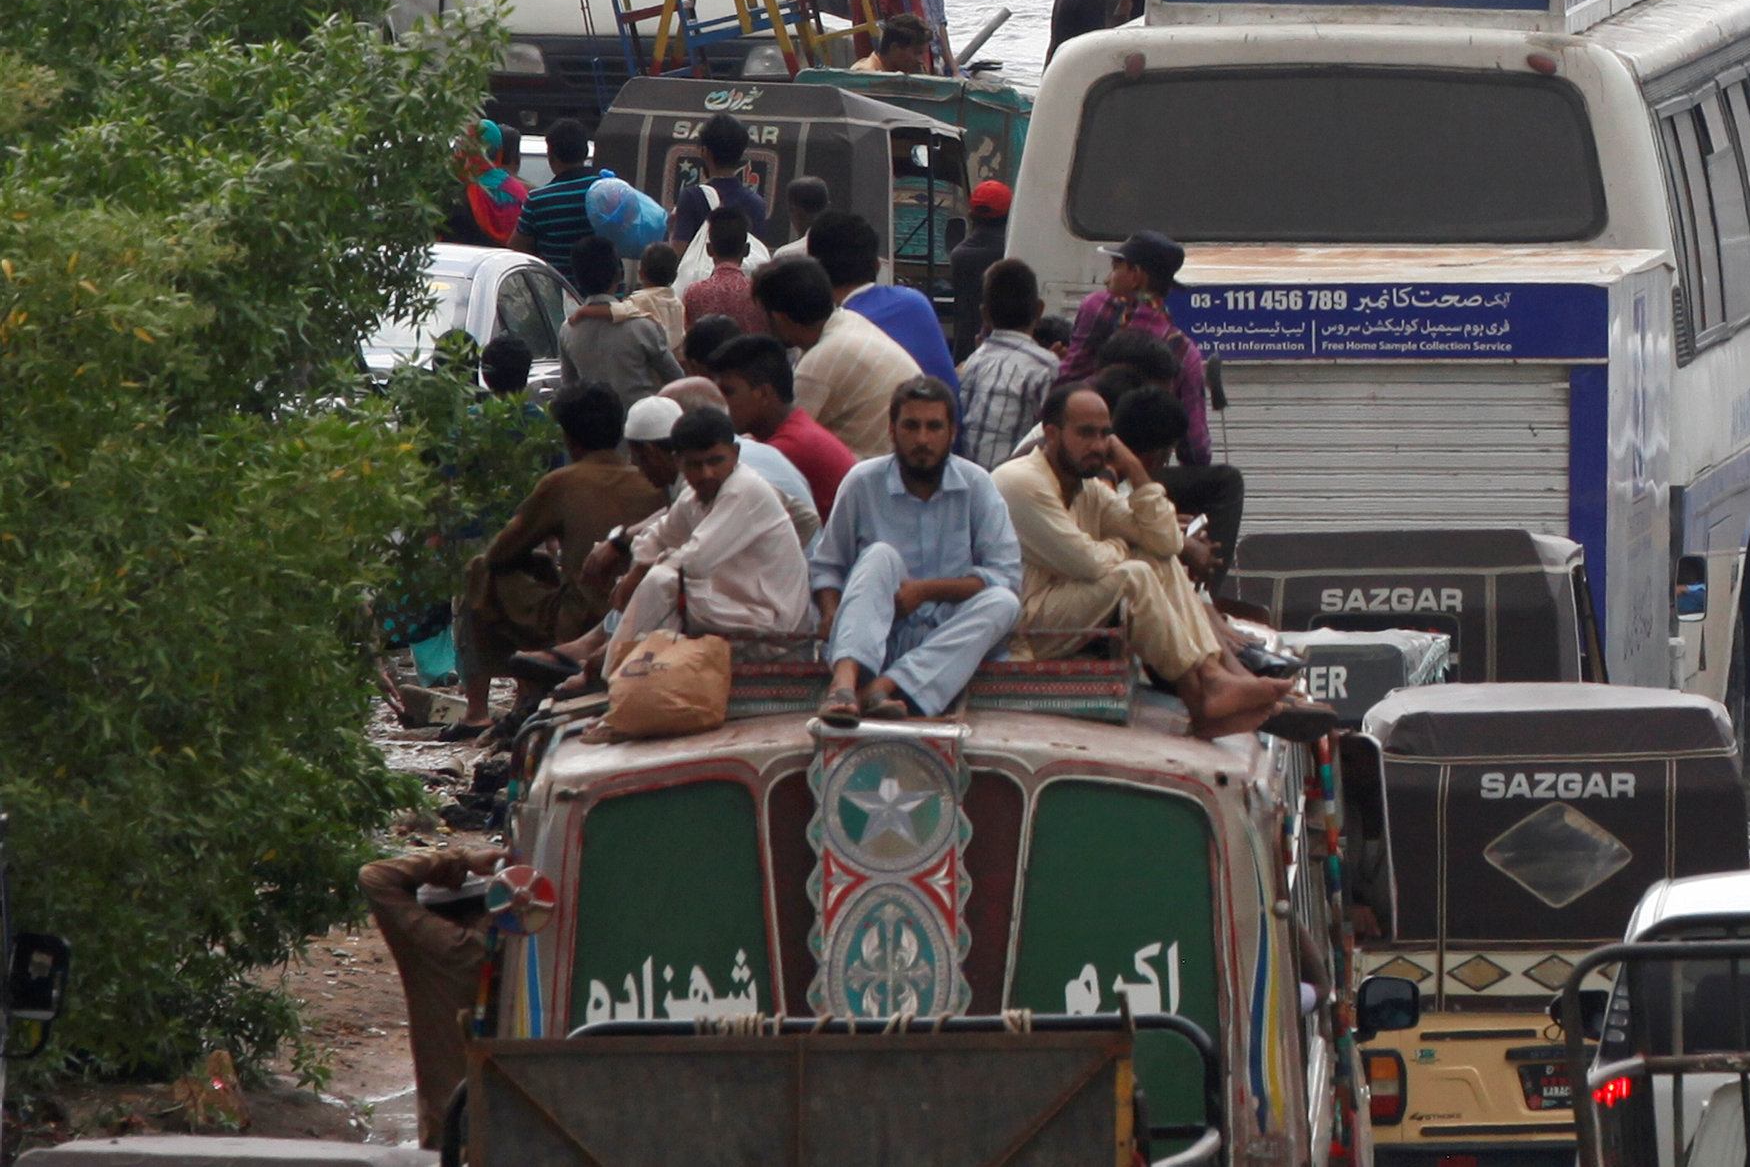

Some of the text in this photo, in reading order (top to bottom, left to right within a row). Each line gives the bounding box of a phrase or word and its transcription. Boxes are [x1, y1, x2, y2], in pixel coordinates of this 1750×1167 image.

[672, 120, 780, 144] SAAR
[1190, 293, 1211, 308] 03
[1224, 290, 1256, 310] 111
[1260, 290, 1303, 310] 456
[1307, 290, 1347, 310] 789
[1353, 289, 1390, 313] نمبر
[1392, 286, 1413, 308] کا
[1412, 290, 1483, 308] صحت
[1191, 321, 1243, 336] معلومات
[1281, 322, 1305, 337] لیب
[1321, 323, 1361, 336] سروس
[1486, 319, 1511, 336] فری
[1213, 341, 1236, 351] Test
[1238, 341, 1305, 351] Information
[1322, 341, 1513, 352] Free Home Sample Collection Service
[1320, 588, 1463, 613] SAZGAR
[1302, 666, 1348, 700] ER
[1480, 772, 1636, 799] SAZGAR
[1542, 1086, 1572, 1097] KARAC
